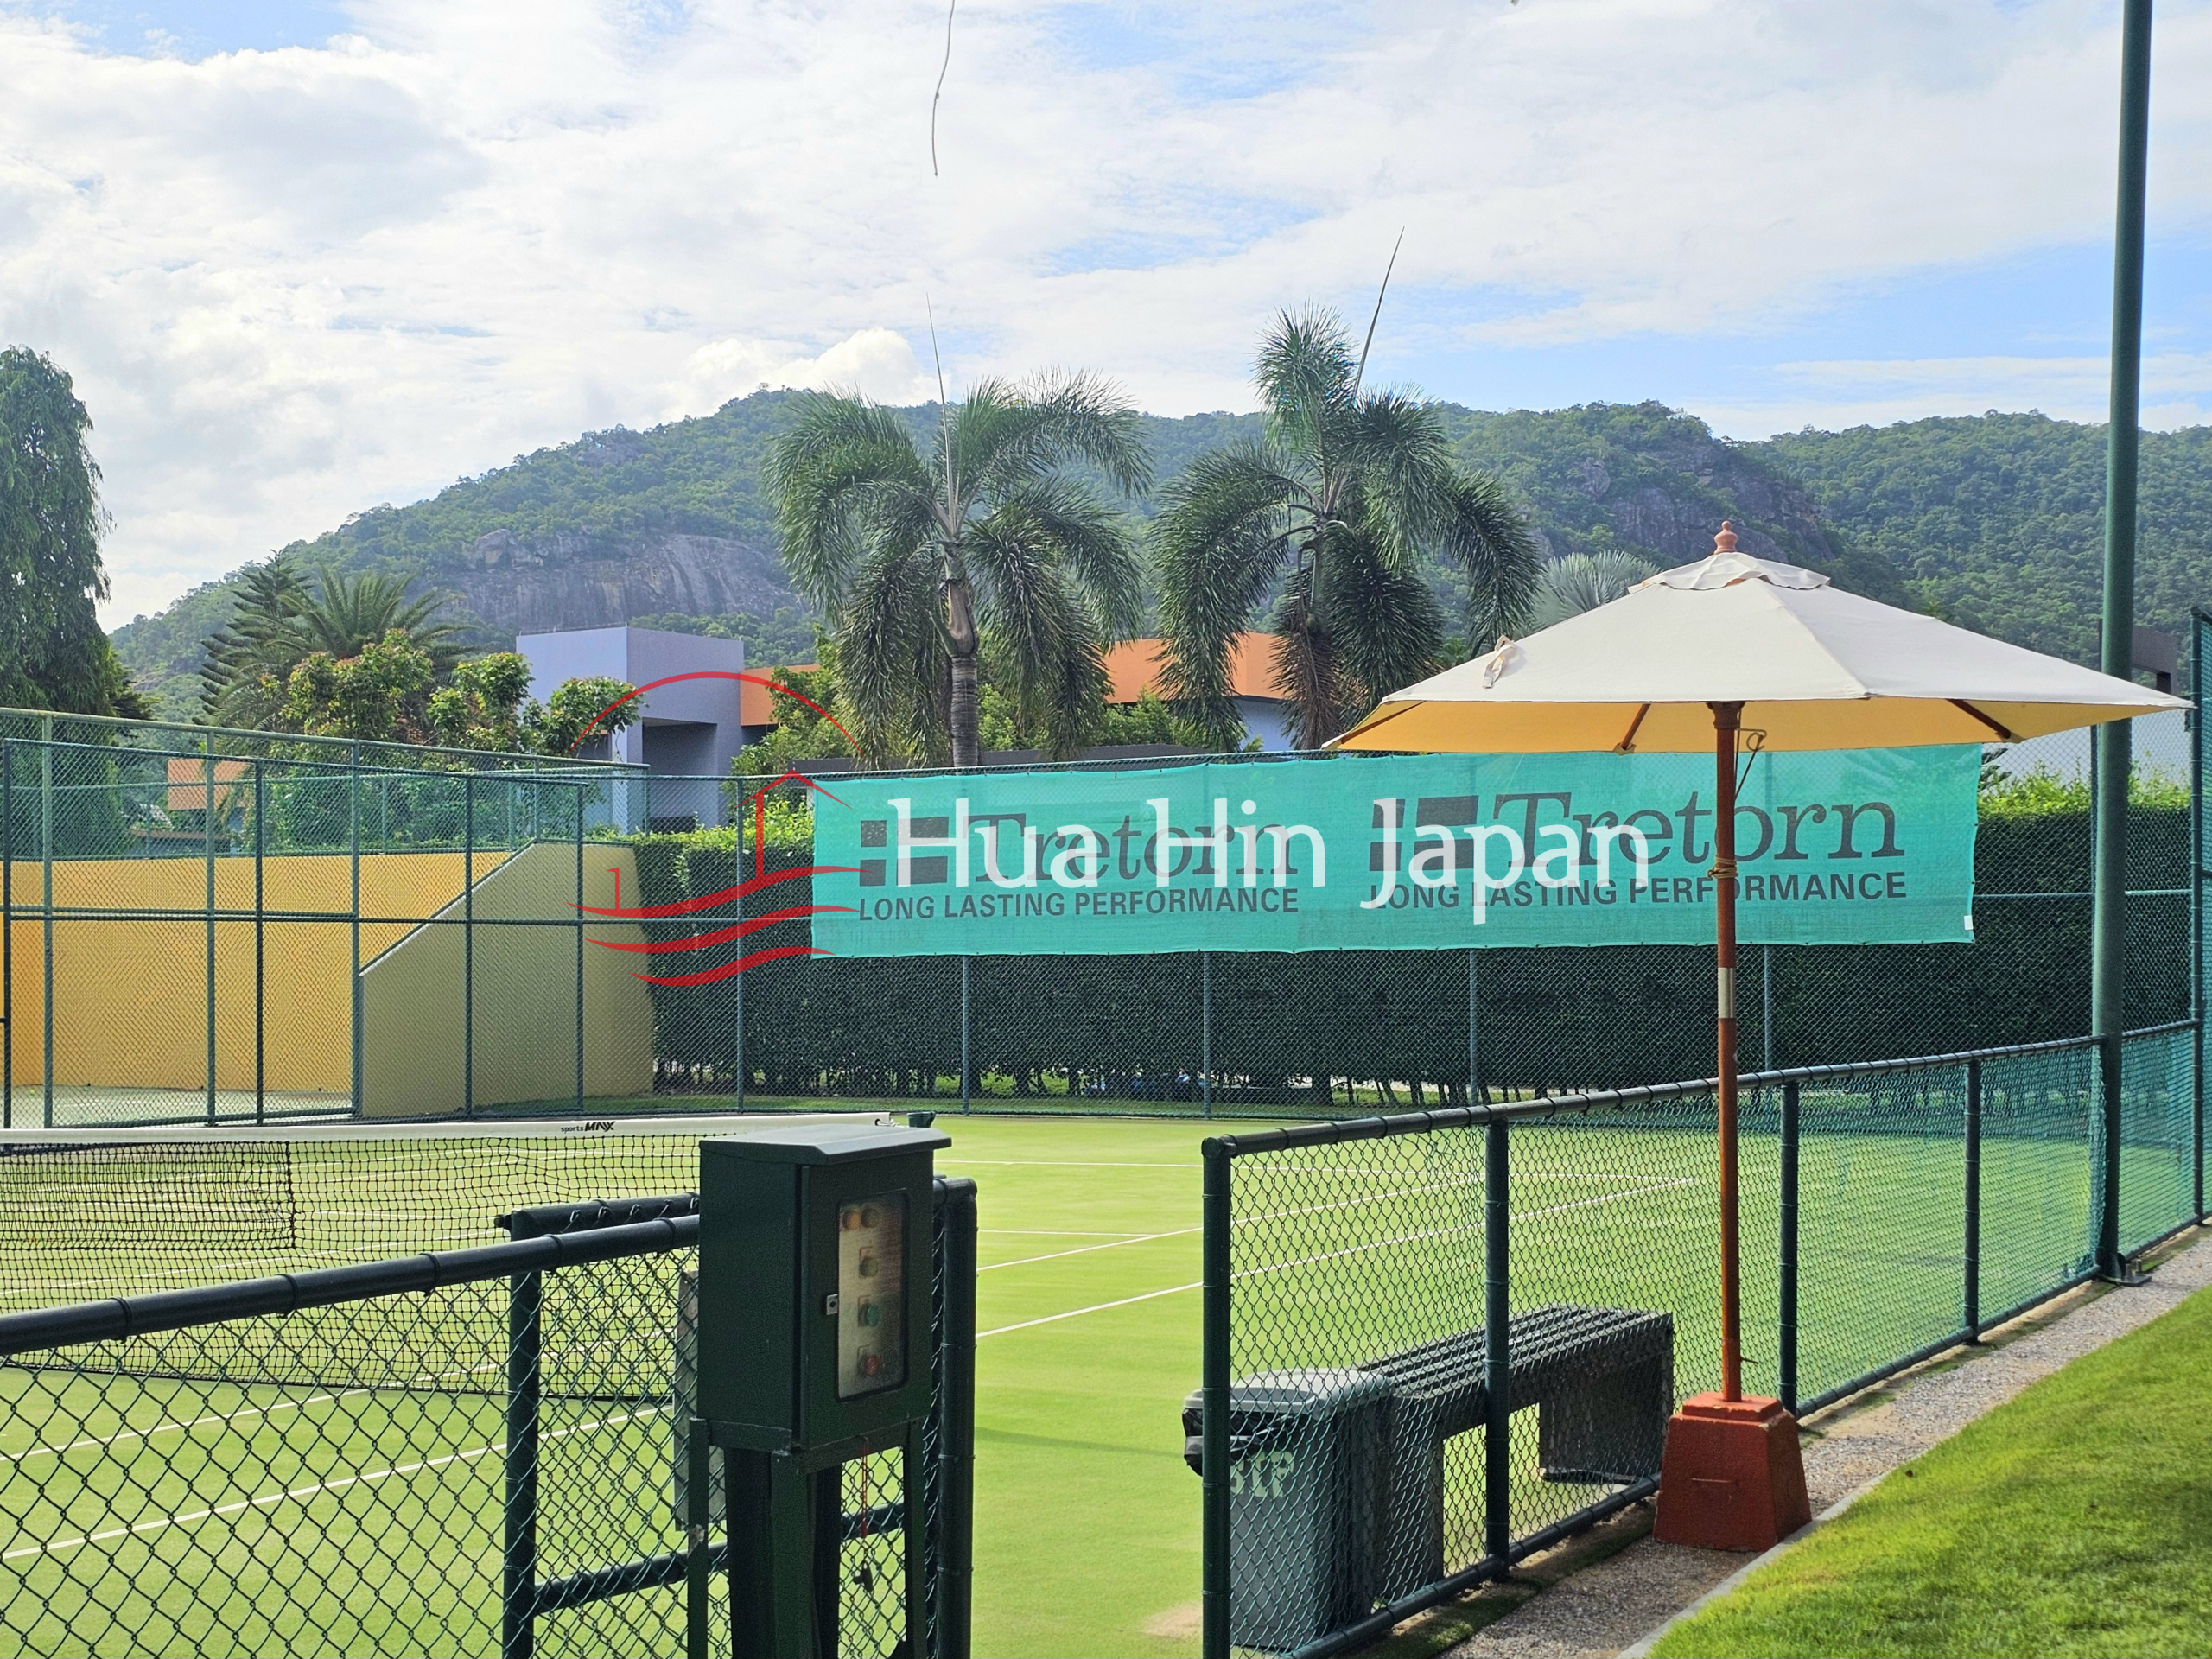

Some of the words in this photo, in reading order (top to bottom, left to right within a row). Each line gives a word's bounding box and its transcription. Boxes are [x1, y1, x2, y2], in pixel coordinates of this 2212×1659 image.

[962, 813, 1299, 883] Tretorn
[1493, 791, 1905, 868] Tretorn
[860, 896, 935, 921] LONG
[944, 893, 1065, 918] LASTING
[1075, 887, 1299, 915] PERFORMANCE
[1370, 884, 1460, 910] LONG
[1471, 879, 1617, 907] LASTING
